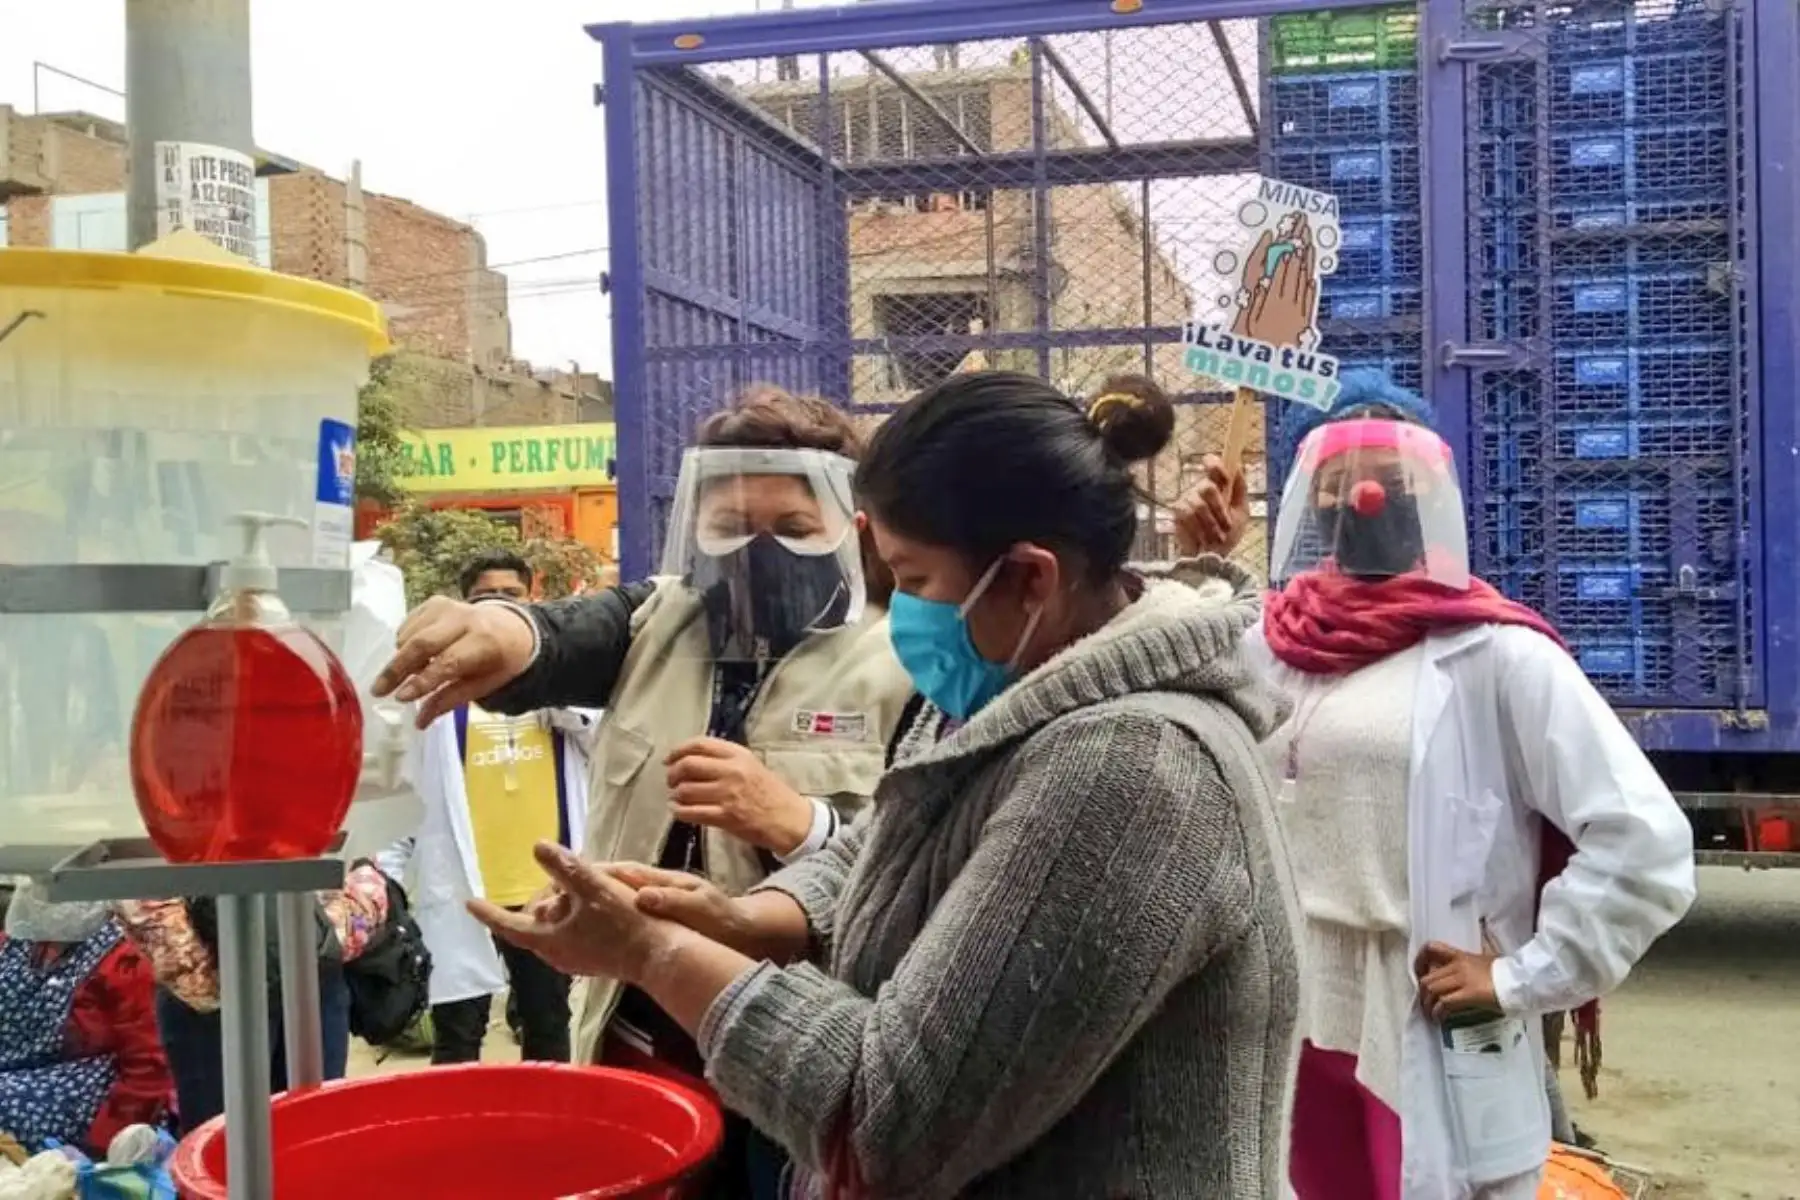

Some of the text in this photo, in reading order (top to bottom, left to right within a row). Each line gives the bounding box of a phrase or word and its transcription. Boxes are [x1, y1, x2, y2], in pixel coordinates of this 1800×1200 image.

[1258, 179, 1338, 219] MINSA
[1184, 348, 1338, 409] manos!
[1281, 348, 1334, 377] tus
